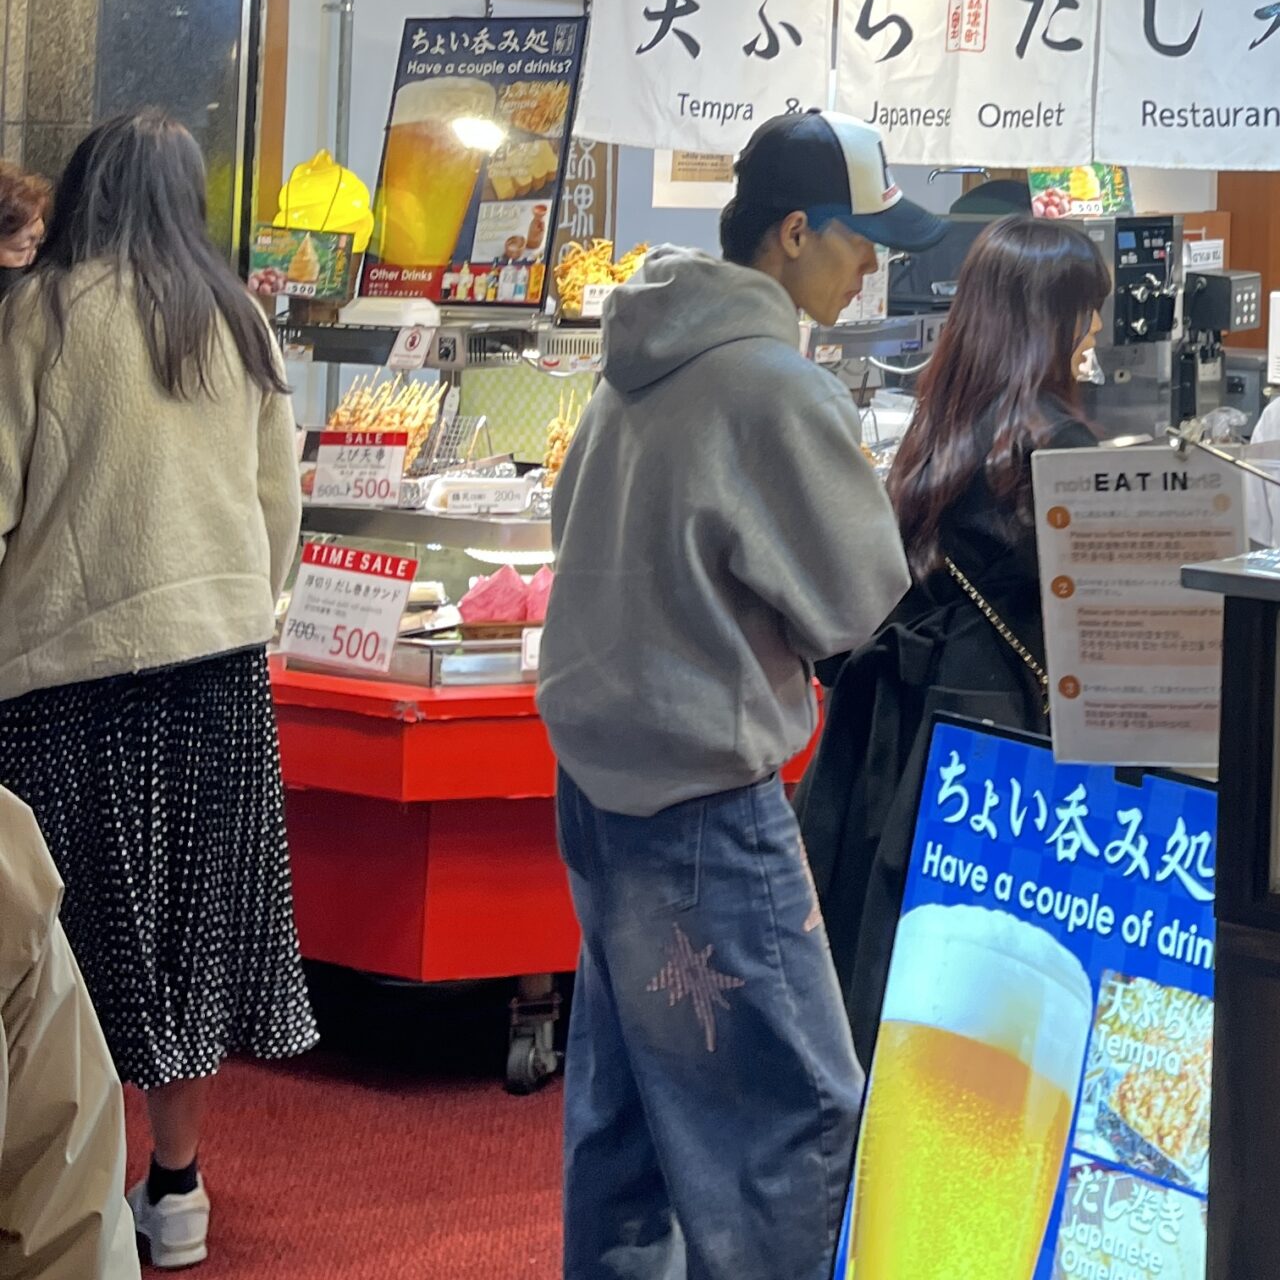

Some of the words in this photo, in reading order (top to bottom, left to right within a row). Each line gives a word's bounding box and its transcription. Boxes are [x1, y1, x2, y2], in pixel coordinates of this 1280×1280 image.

[411, 26, 550, 56] ちょい呑み処
[406, 60, 442, 75] Have
[445, 65, 454, 74] a
[457, 61, 504, 76] couple
[507, 60, 522, 74] of
[524, 59, 573, 74] drinks?
[677, 93, 754, 125] Tempra
[864, 100, 951, 133] Japanese
[977, 100, 1065, 129] Omelet
[369, 268, 400, 281] Other
[401, 268, 433, 281] Drinks
[345, 432, 383, 444] SALE
[1094, 472, 1149, 492] EAT
[1163, 471, 1188, 491] IN
[311, 545, 357, 569] TIME
[359, 552, 410, 577] SALE
[935, 749, 1216, 903] ちょい呑み処
[922, 839, 988, 893] Have
[994, 873, 1011, 902] a
[1018, 879, 1115, 939] couple
[1120, 910, 1154, 948] of
[1157, 923, 1216, 971] drin
[1102, 979, 1192, 1041] 天ぷら
[1096, 1023, 1181, 1076] Tempra
[1071, 1166, 1184, 1244] だし巻き
[1063, 1214, 1164, 1275] Japanese
